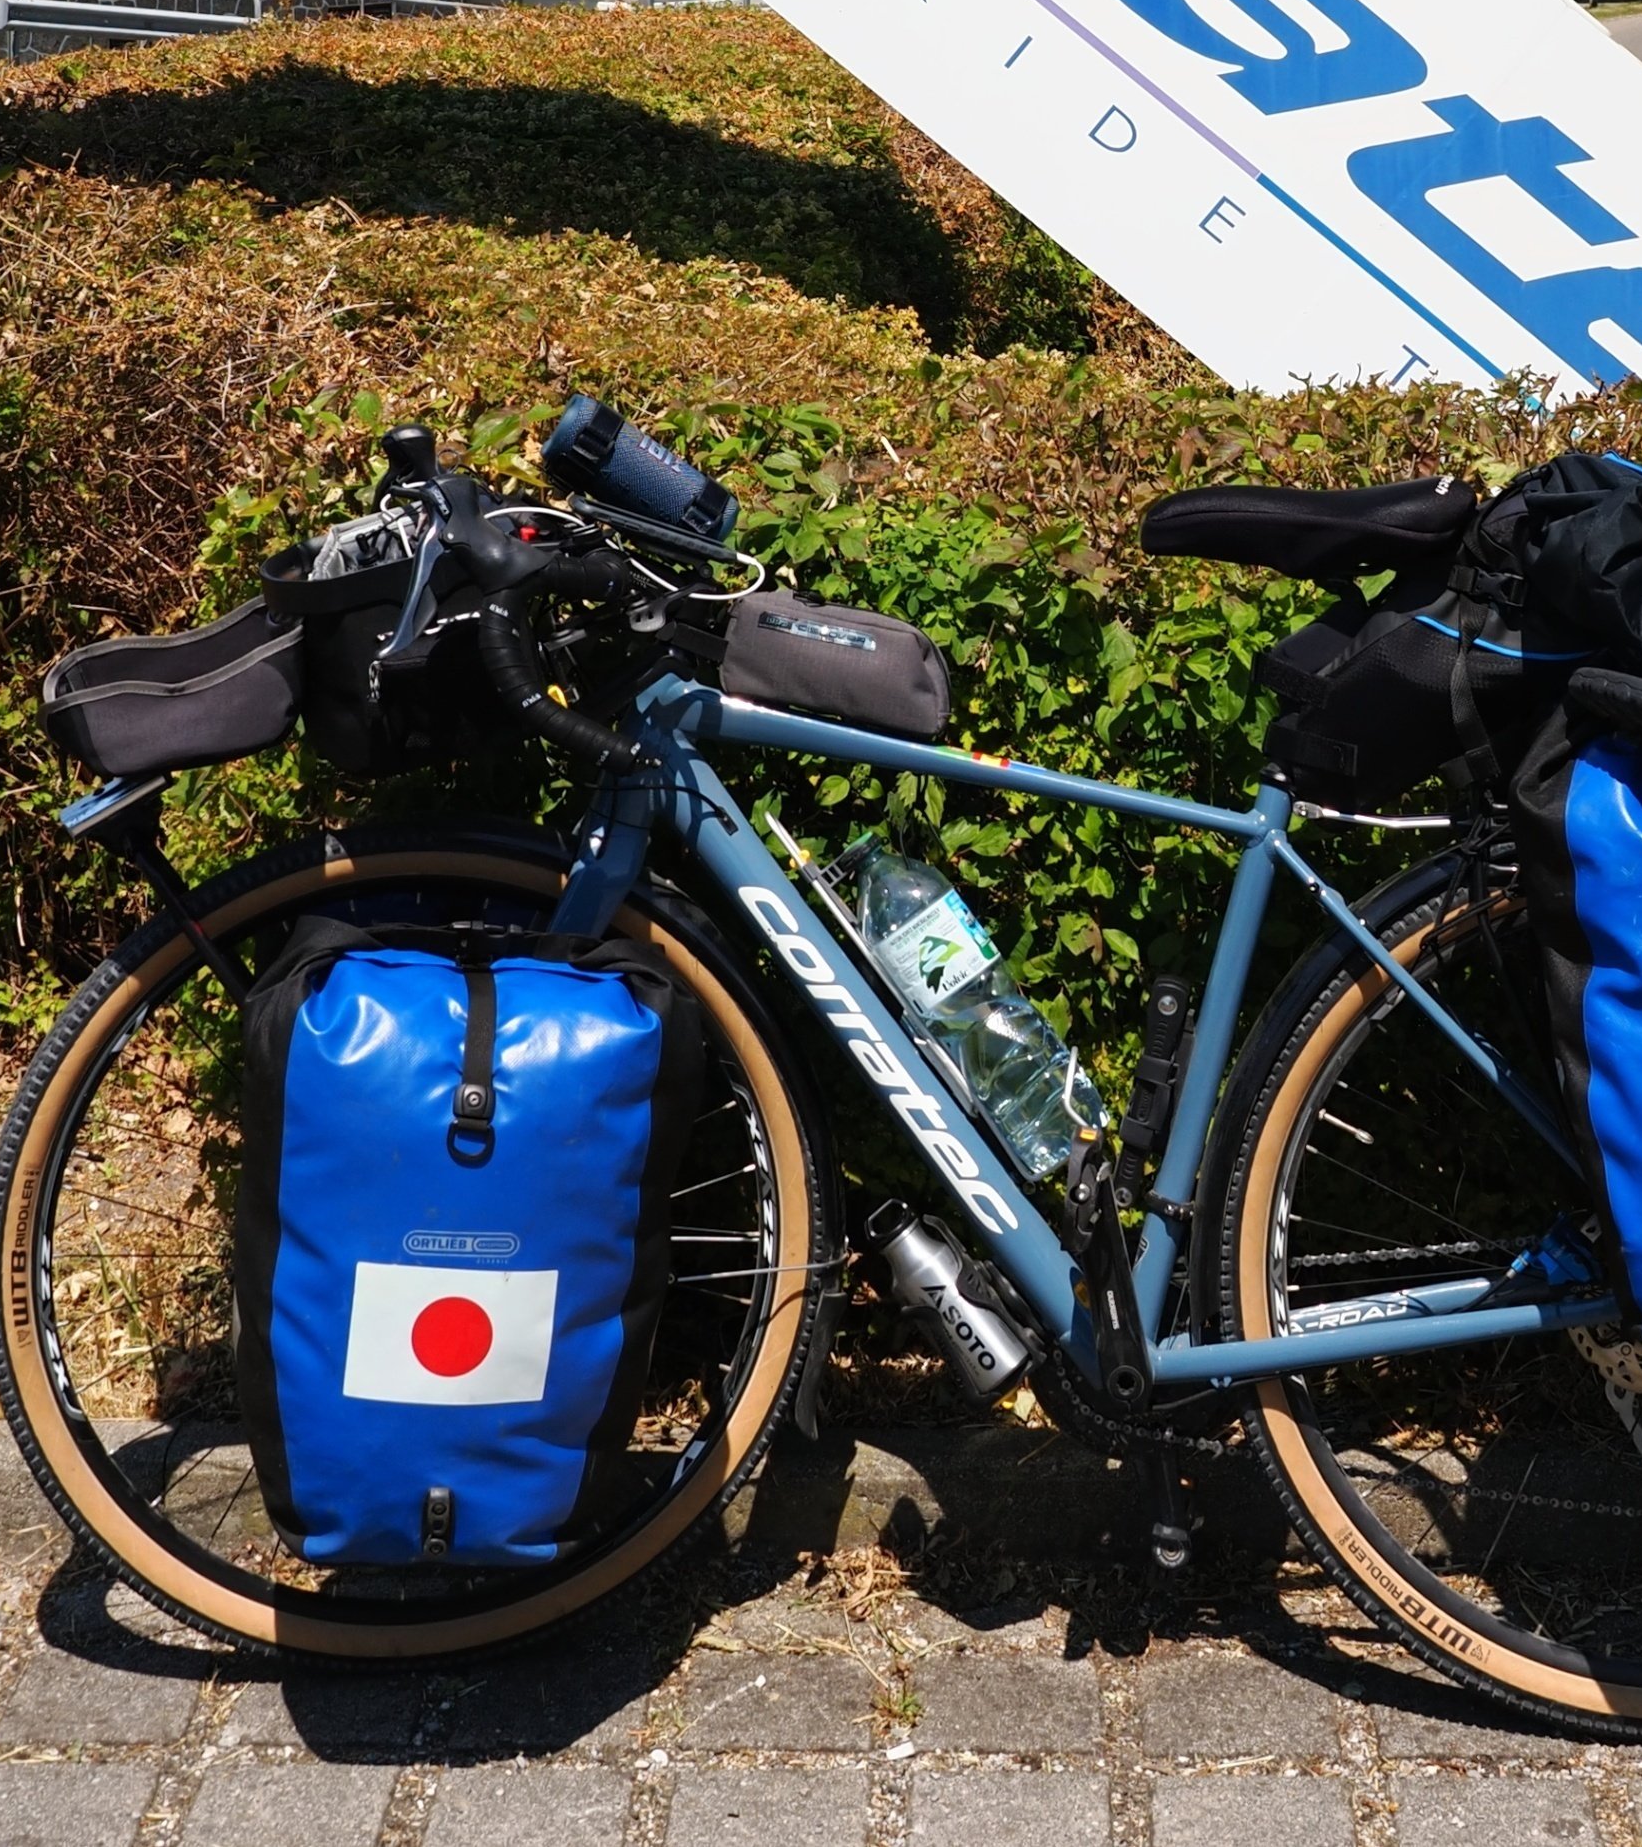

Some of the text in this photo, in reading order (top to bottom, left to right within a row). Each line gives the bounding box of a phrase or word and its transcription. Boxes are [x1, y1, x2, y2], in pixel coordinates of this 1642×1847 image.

[737, 884, 1019, 1237] corratec
[14, 1178, 36, 1249] RIDDLER
[410, 1237, 468, 1250] ORTLIEB
[11, 1249, 30, 1328] WTB
[1347, 1538, 1473, 1654] WTB RIDDLER
